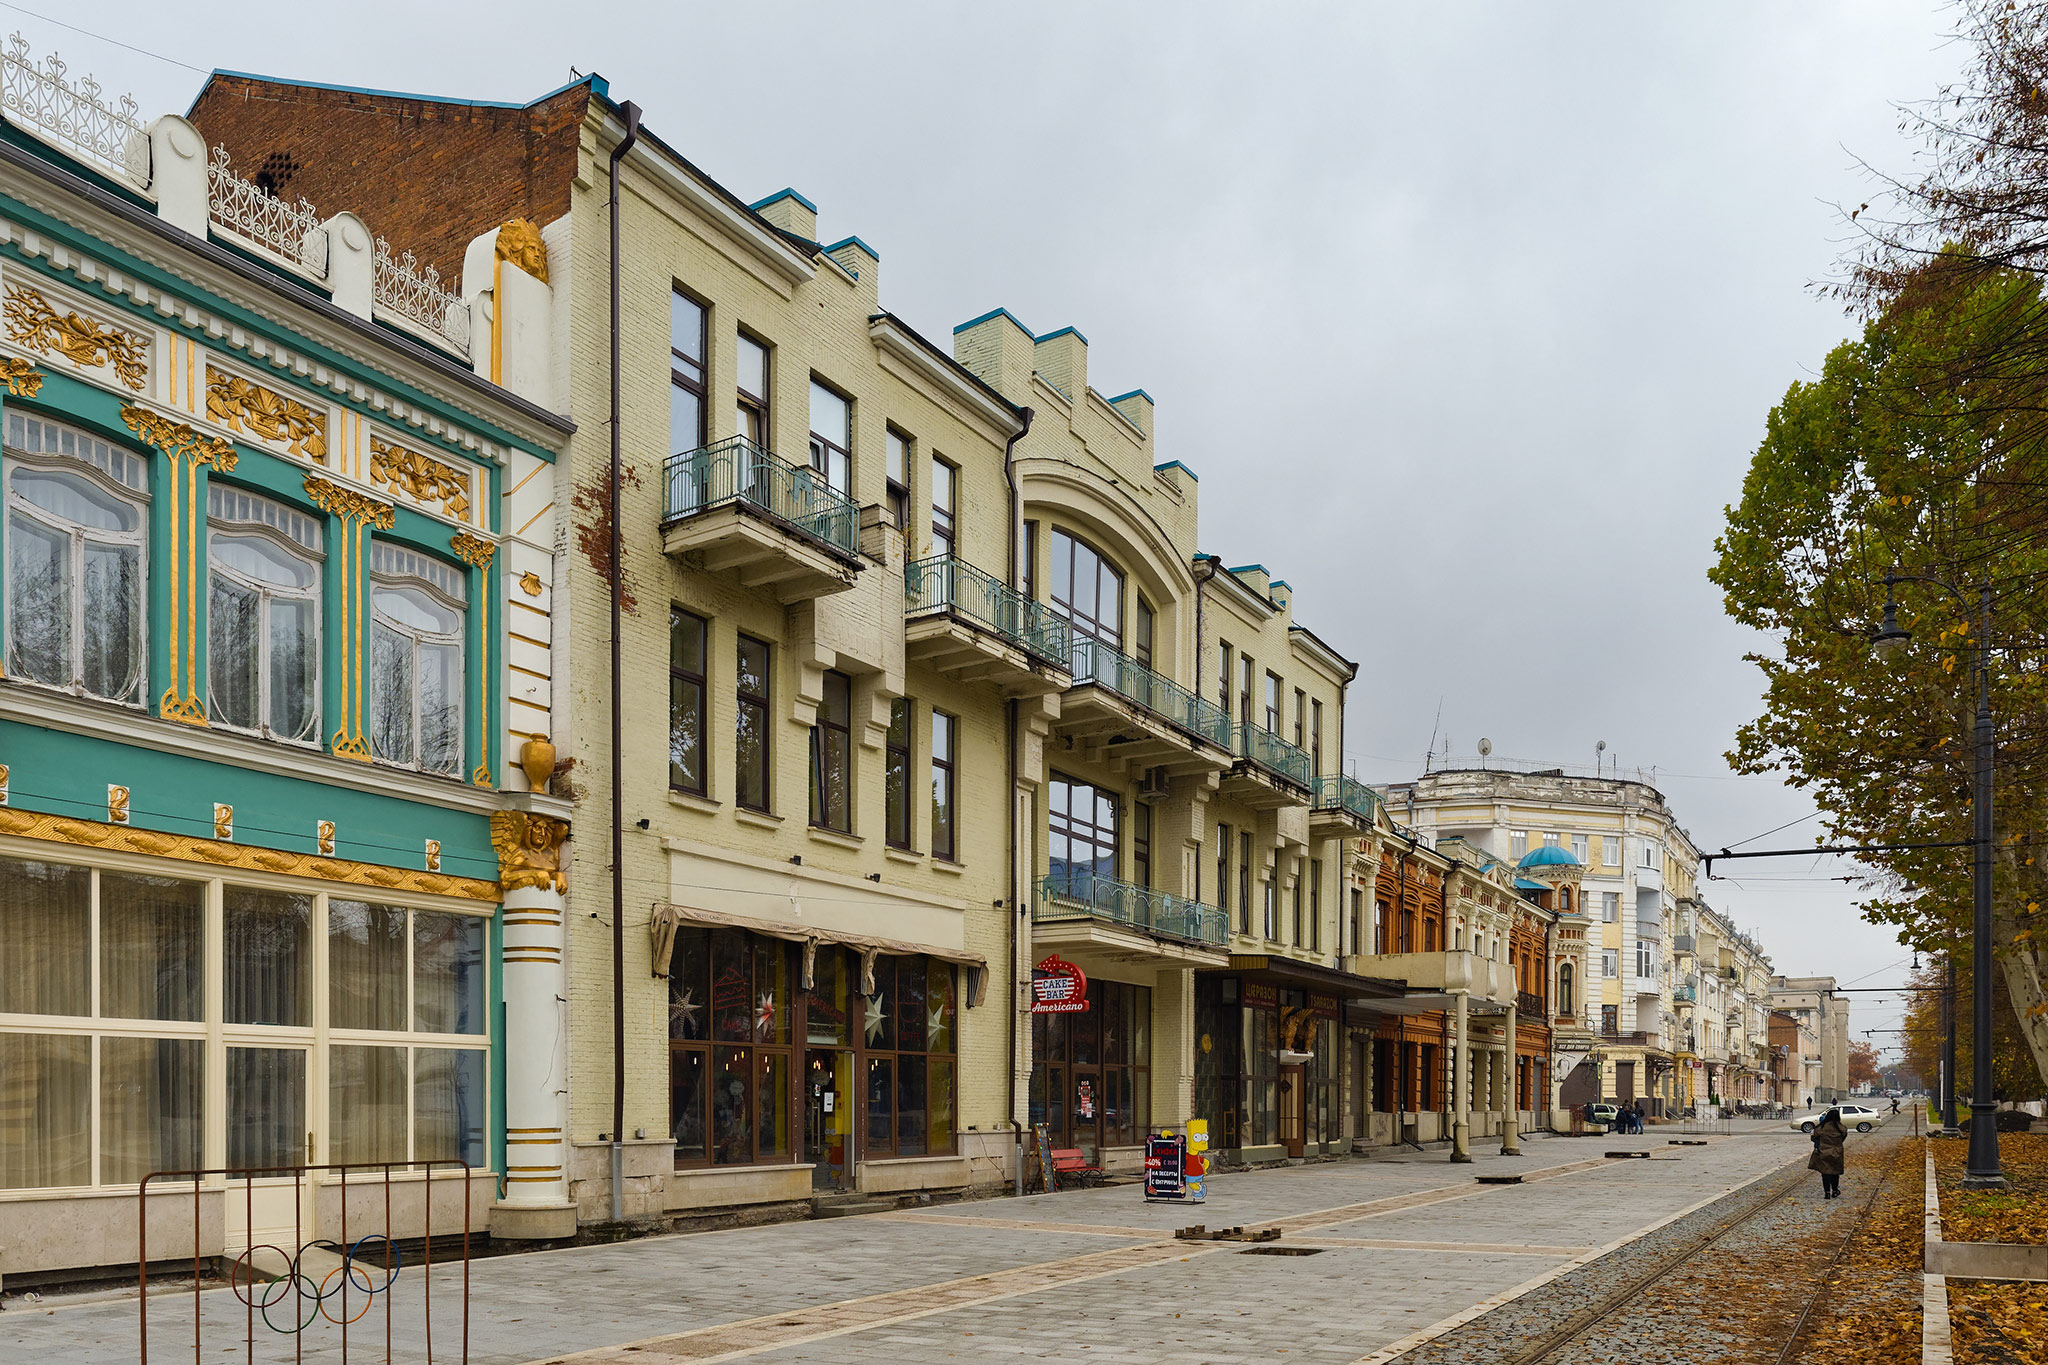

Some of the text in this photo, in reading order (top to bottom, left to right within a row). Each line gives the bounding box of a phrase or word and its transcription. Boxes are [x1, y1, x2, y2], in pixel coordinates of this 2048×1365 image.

[1042, 979, 1068, 989] CAKE
[1046, 990, 1065, 999] BAR
[1031, 1002, 1083, 1012] Americano
[1145, 1158, 1161, 1167] -40%
